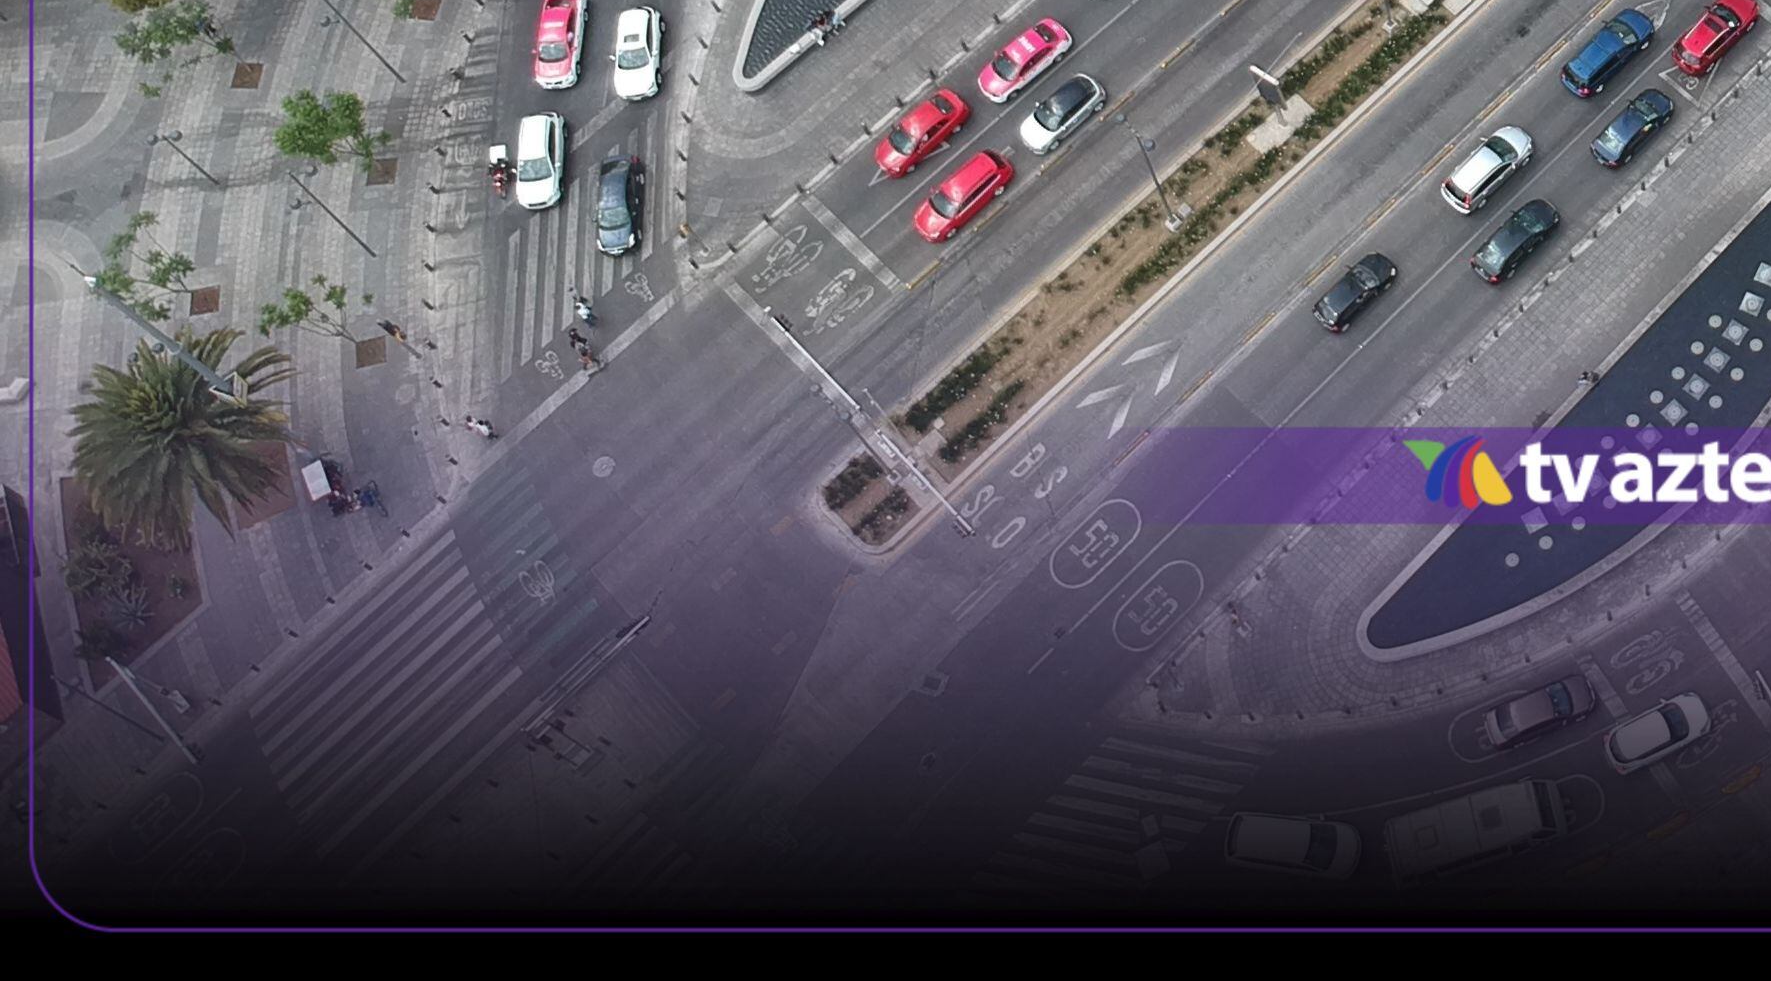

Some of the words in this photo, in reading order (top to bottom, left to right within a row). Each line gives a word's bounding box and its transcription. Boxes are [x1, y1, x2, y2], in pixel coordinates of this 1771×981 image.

[1009, 442, 1068, 499] BS
[961, 484, 1026, 549] SOO
[1069, 518, 1120, 568] 50
[1127, 585, 1178, 636] 50
